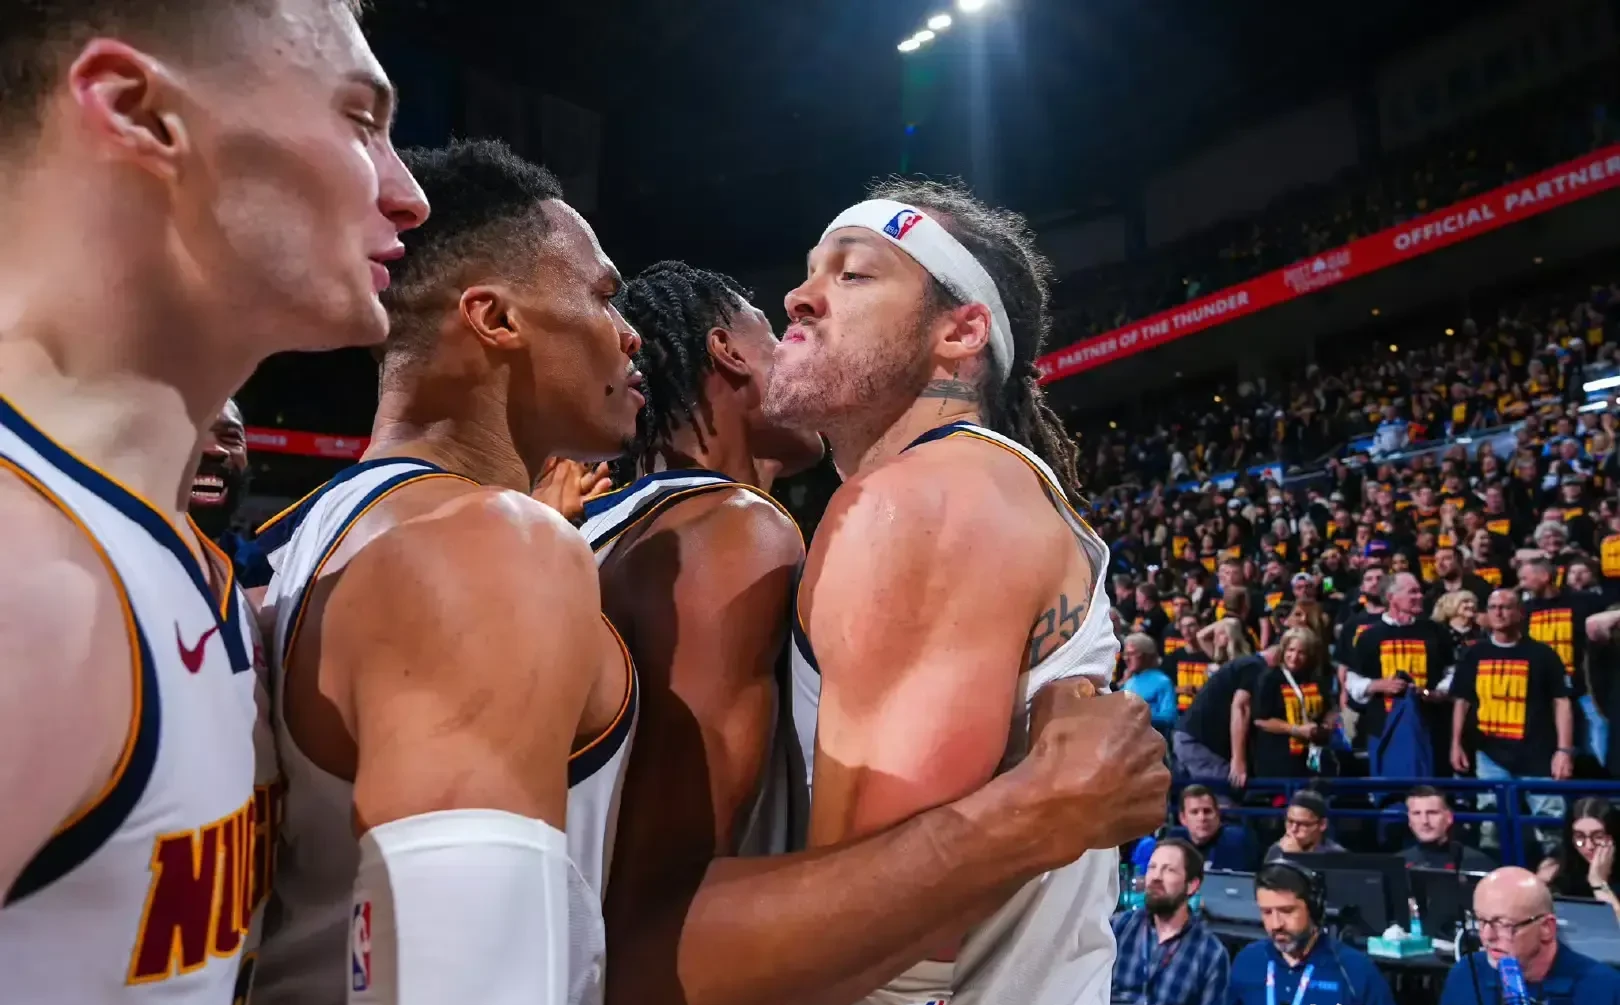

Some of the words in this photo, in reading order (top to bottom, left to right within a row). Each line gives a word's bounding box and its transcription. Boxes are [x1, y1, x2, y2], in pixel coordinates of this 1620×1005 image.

[1393, 203, 1496, 251] OFFICIAL
[1504, 154, 1620, 213] PARTNER
[1057, 338, 1118, 370] PARTNER
[1118, 329, 1140, 348] OF
[1141, 318, 1171, 341] THE
[1172, 290, 1250, 329] THUNDER
